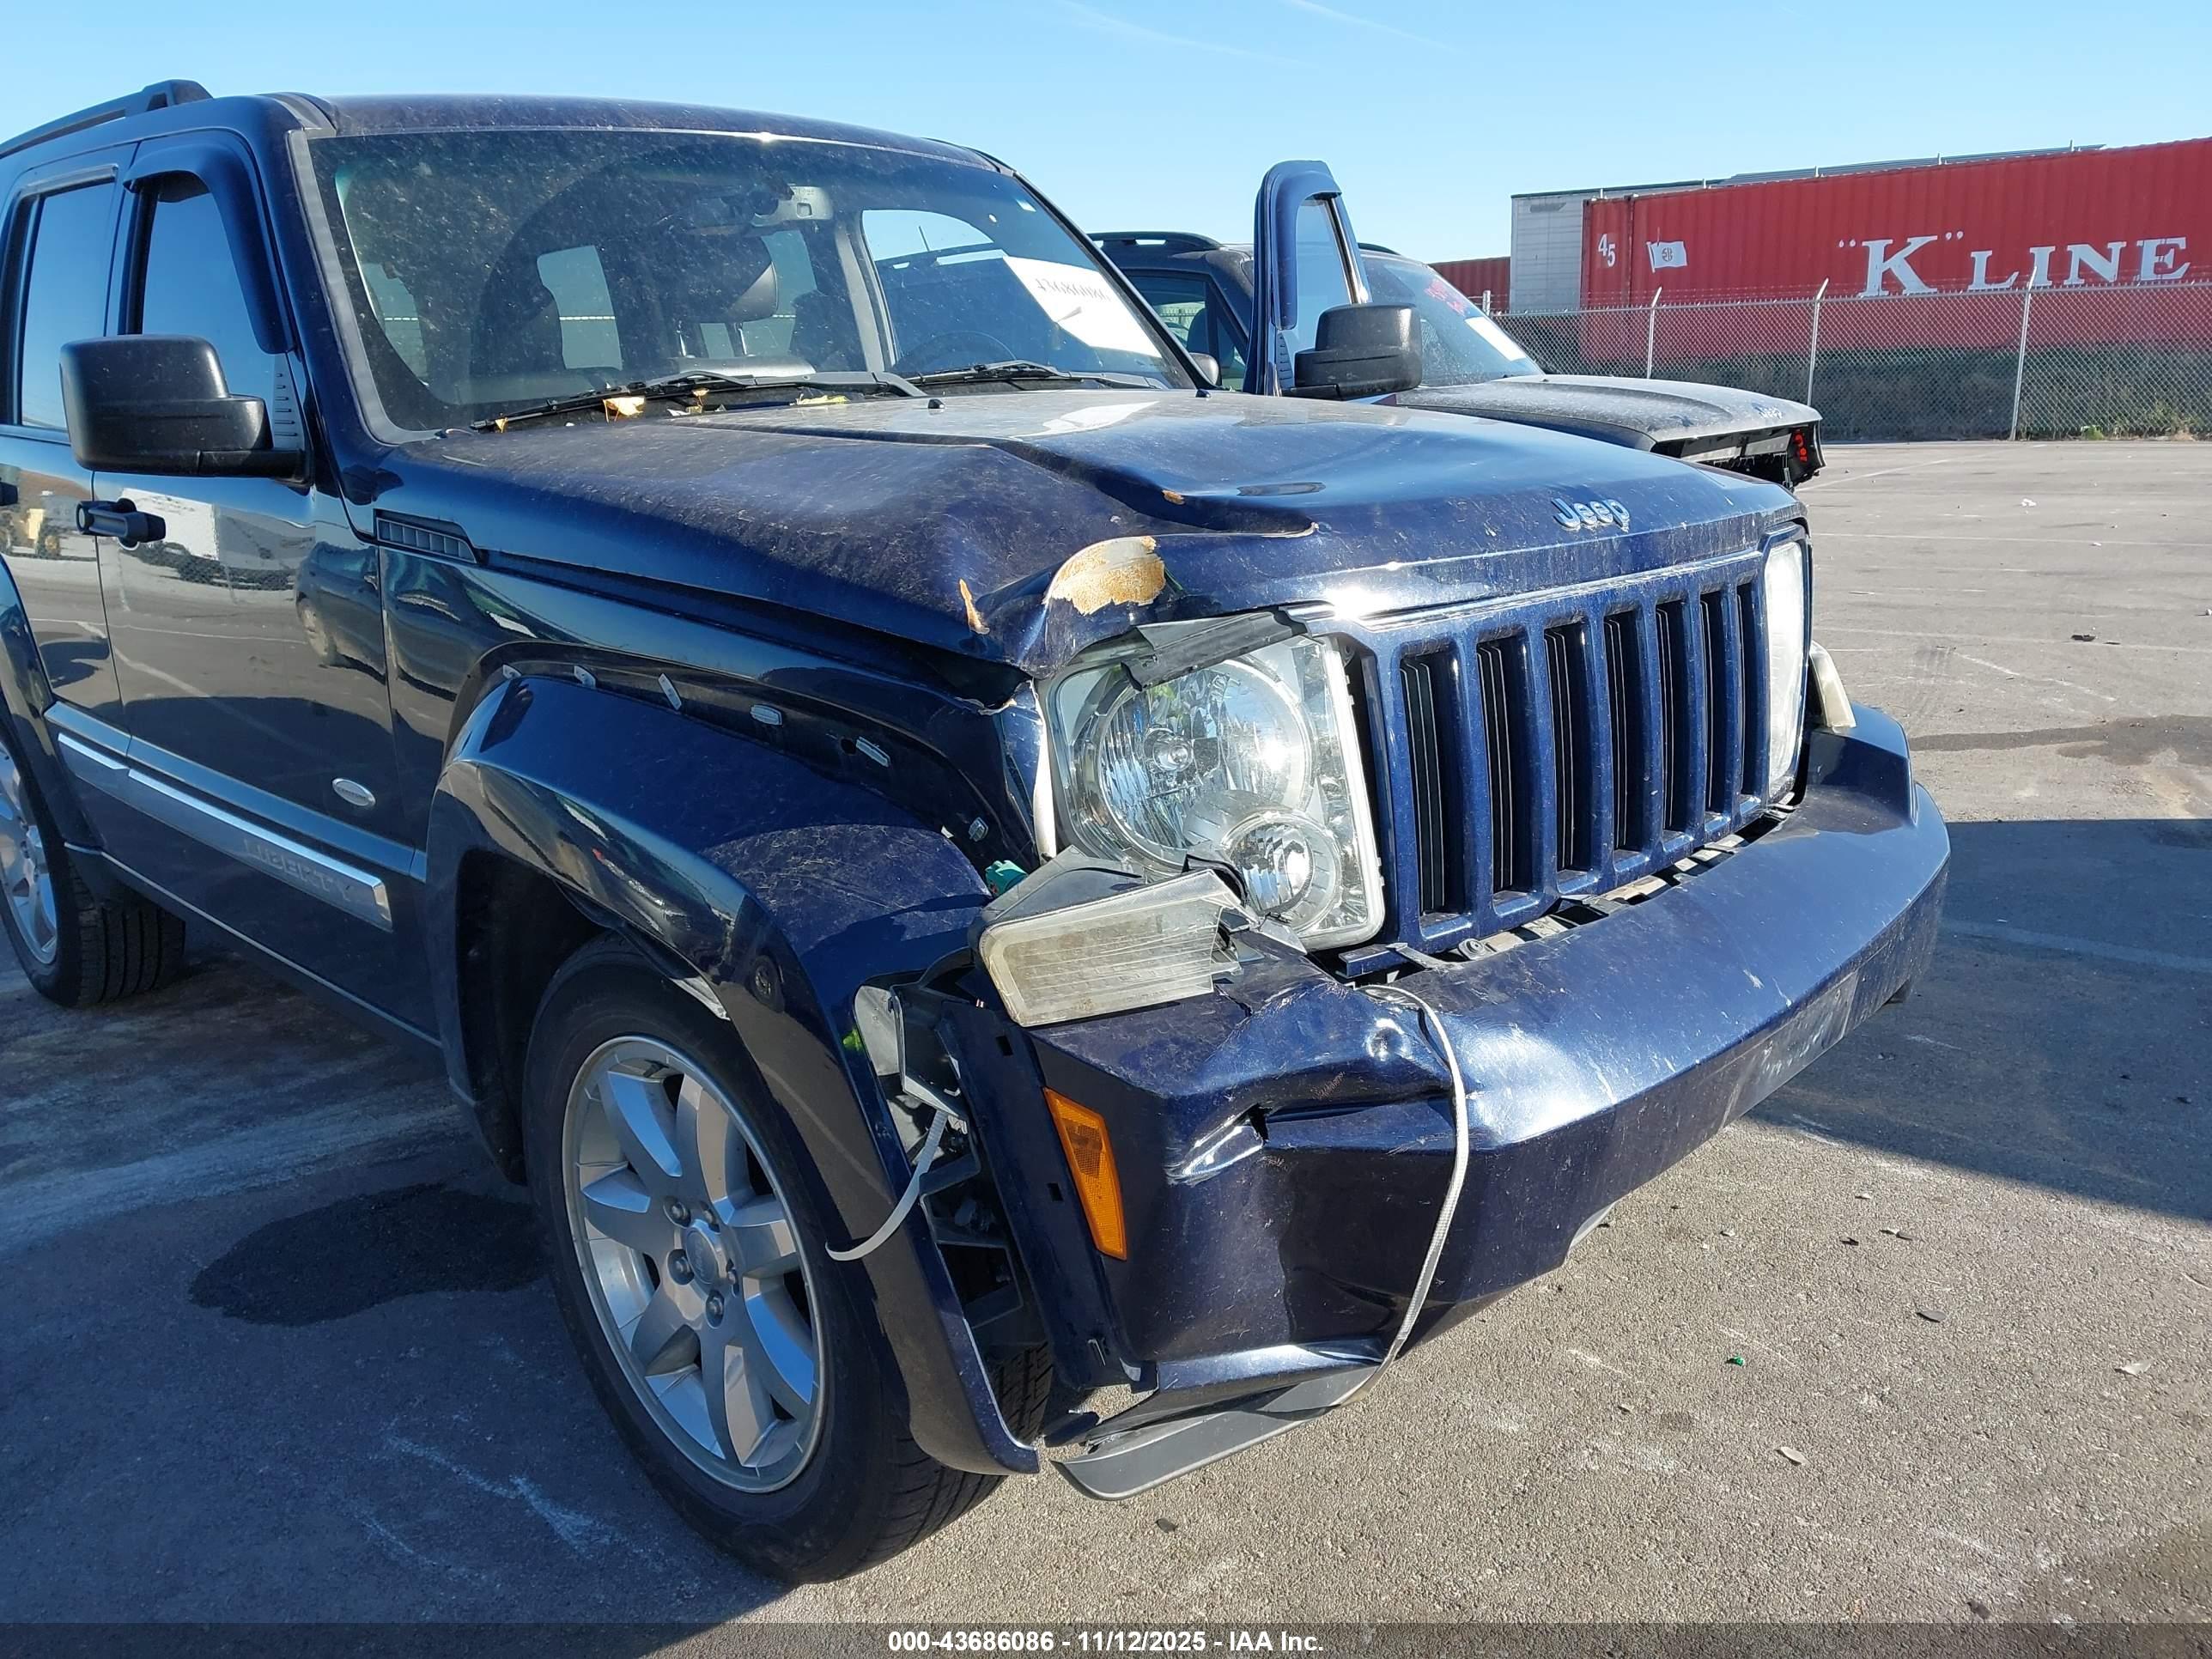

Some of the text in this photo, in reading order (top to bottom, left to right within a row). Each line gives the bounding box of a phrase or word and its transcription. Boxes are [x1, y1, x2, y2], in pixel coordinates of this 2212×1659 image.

[1598, 233, 1616, 268] 45
[1966, 236, 2191, 293] LINE
[1551, 497, 1630, 533] Jeep
[242, 838, 356, 902] LIBERTY
